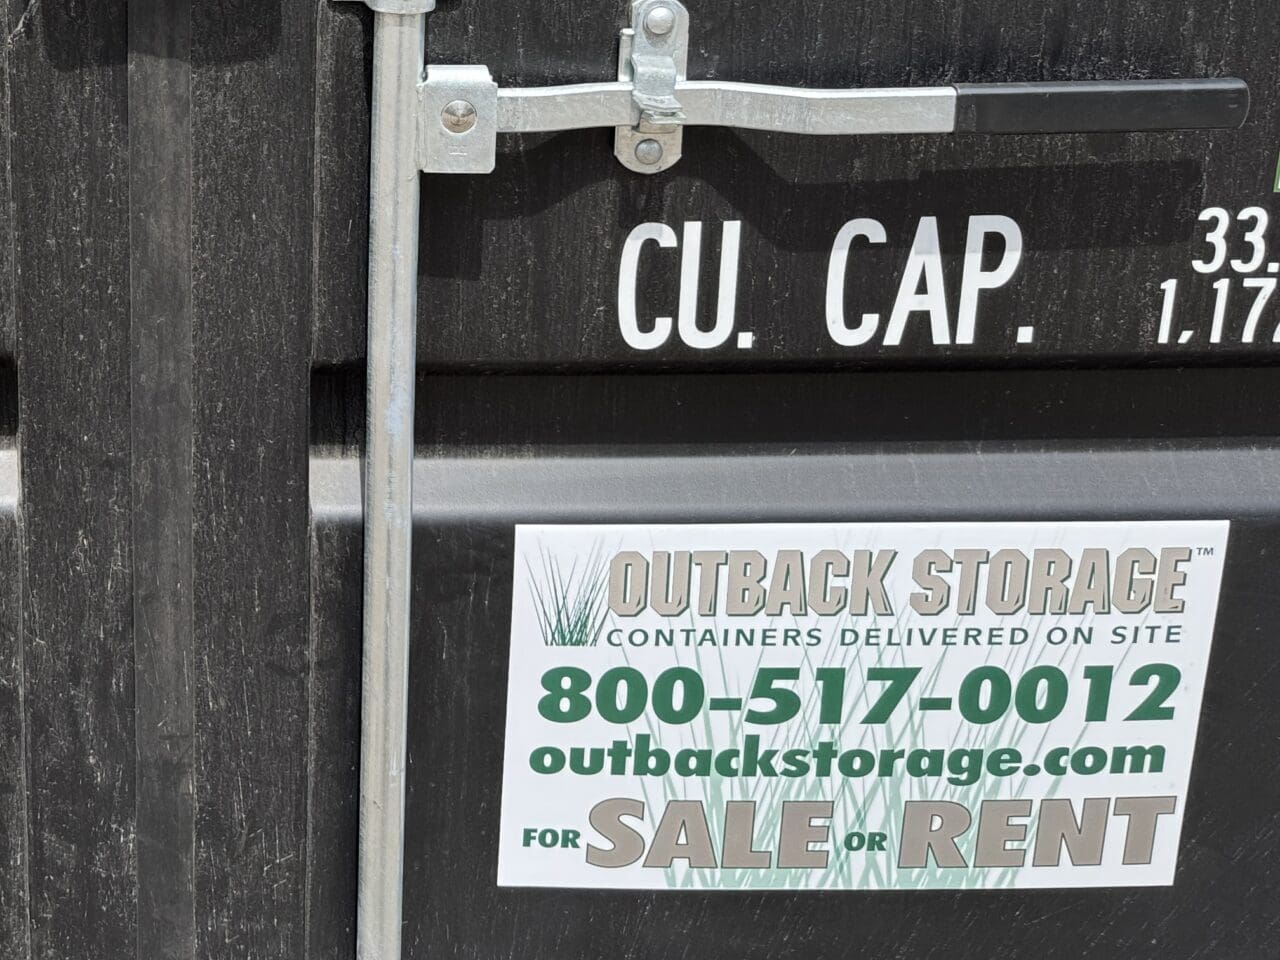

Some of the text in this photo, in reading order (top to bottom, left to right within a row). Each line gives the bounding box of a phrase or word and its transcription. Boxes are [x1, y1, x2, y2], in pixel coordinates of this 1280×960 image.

[617, 214, 1035, 350] CU. CAP.
[1157, 278, 1280, 344] 1,17
[608, 547, 899, 619] OUTBACK
[908, 546, 1194, 618] STORAGE
[606, 624, 1183, 649] CONTAINERS DELIVERED ON SITE
[536, 662, 1183, 726] 800-517-0012
[528, 733, 1166, 787] outbackstorage.com
[521, 795, 1177, 870] FOR SALE OR RENT
